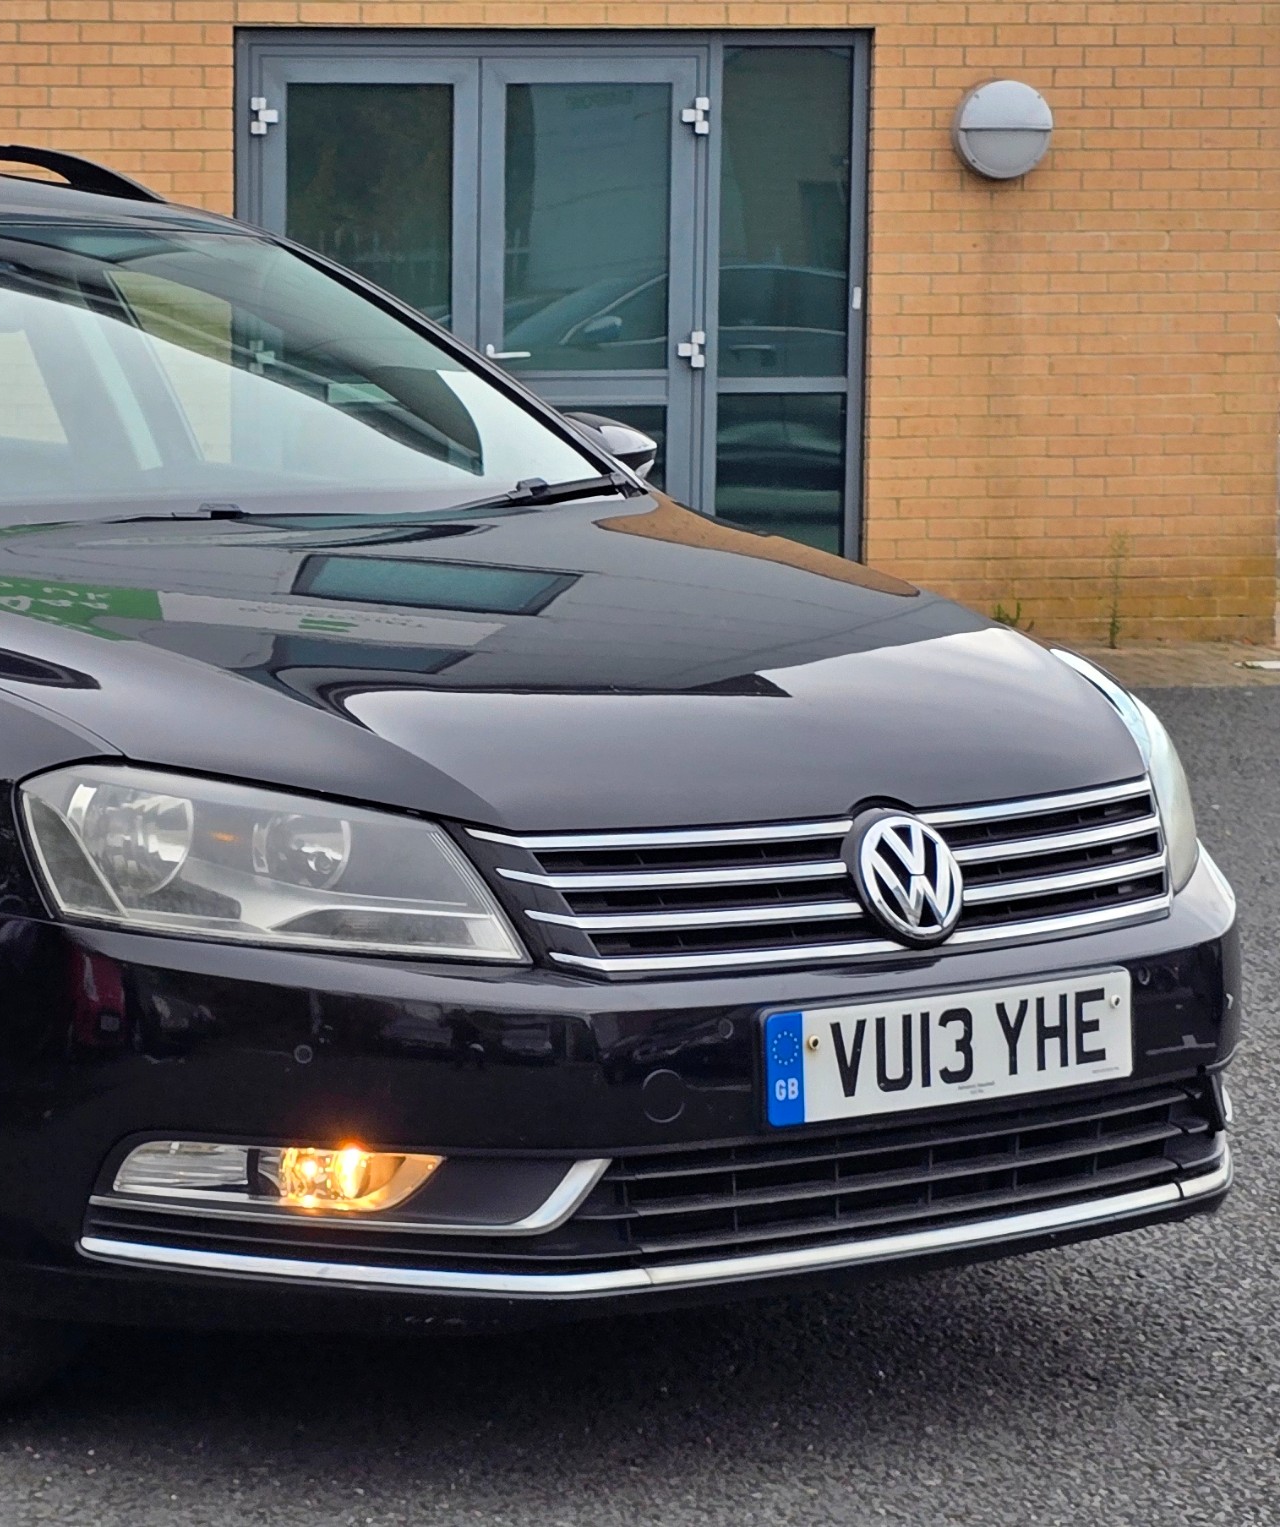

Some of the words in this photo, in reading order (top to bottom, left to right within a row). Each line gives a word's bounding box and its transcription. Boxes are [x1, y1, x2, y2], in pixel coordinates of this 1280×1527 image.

[829, 1007, 974, 1098] VU13
[996, 988, 1106, 1076] YHE
[774, 1077, 799, 1102] GB
